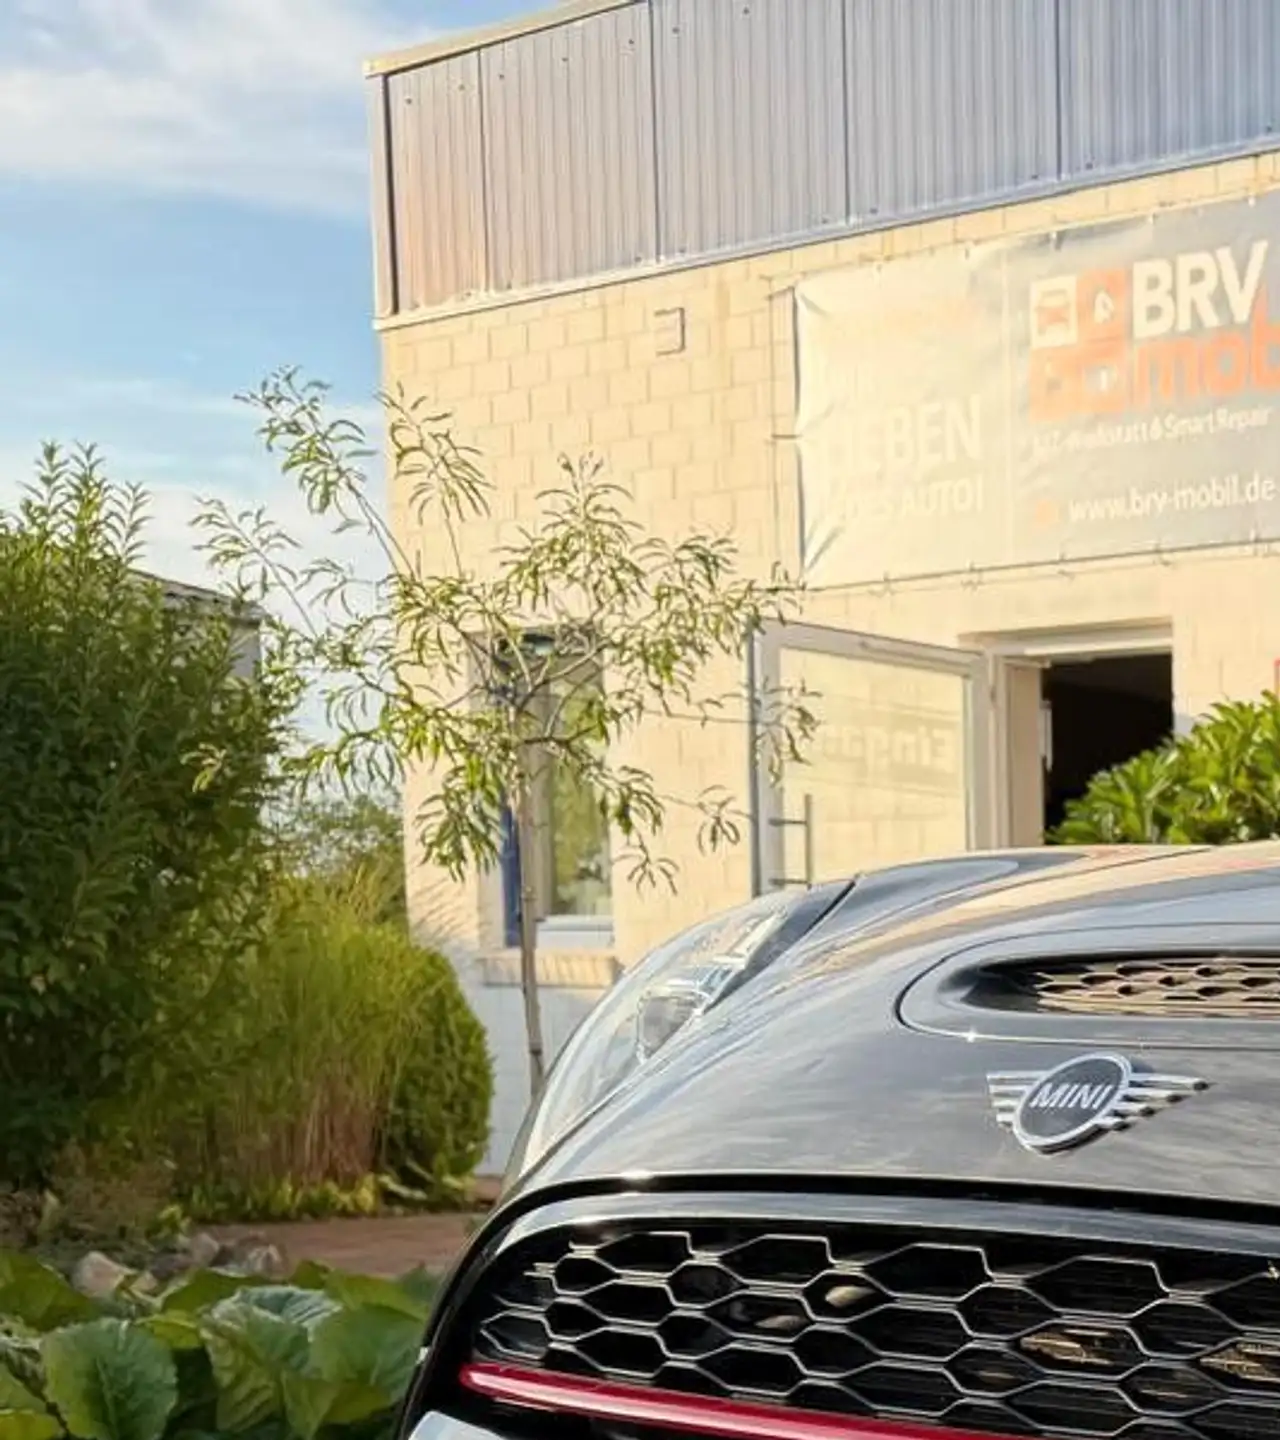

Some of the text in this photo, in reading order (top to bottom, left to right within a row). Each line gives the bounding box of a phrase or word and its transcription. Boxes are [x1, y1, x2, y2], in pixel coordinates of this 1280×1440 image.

[1132, 239, 1269, 341] BRV
[1068, 470, 1277, 523] www.brv-mobil.de
[1029, 1082, 1113, 1109] MINI
